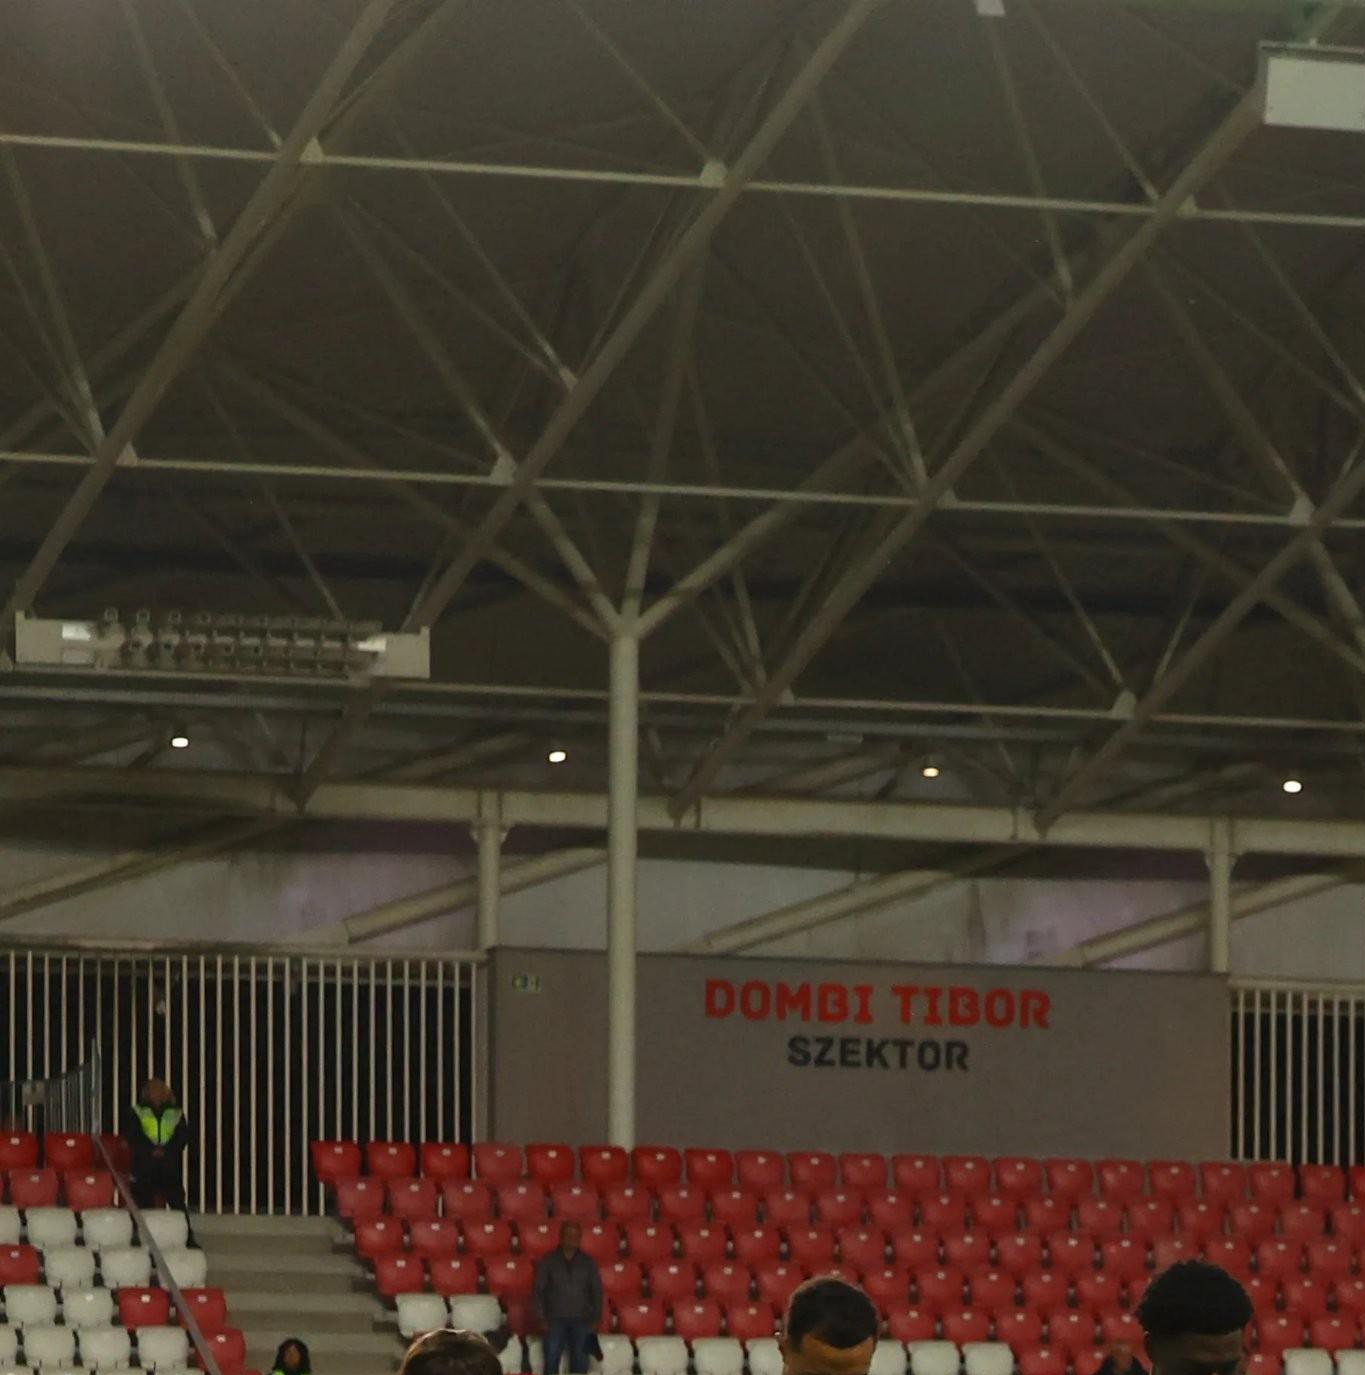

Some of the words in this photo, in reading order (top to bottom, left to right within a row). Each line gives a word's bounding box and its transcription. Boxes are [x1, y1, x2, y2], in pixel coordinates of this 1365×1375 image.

[704, 978, 874, 1025] DOMBI
[891, 983, 1051, 1030] TIBOR
[787, 1035, 970, 1073] SZEKTOR
